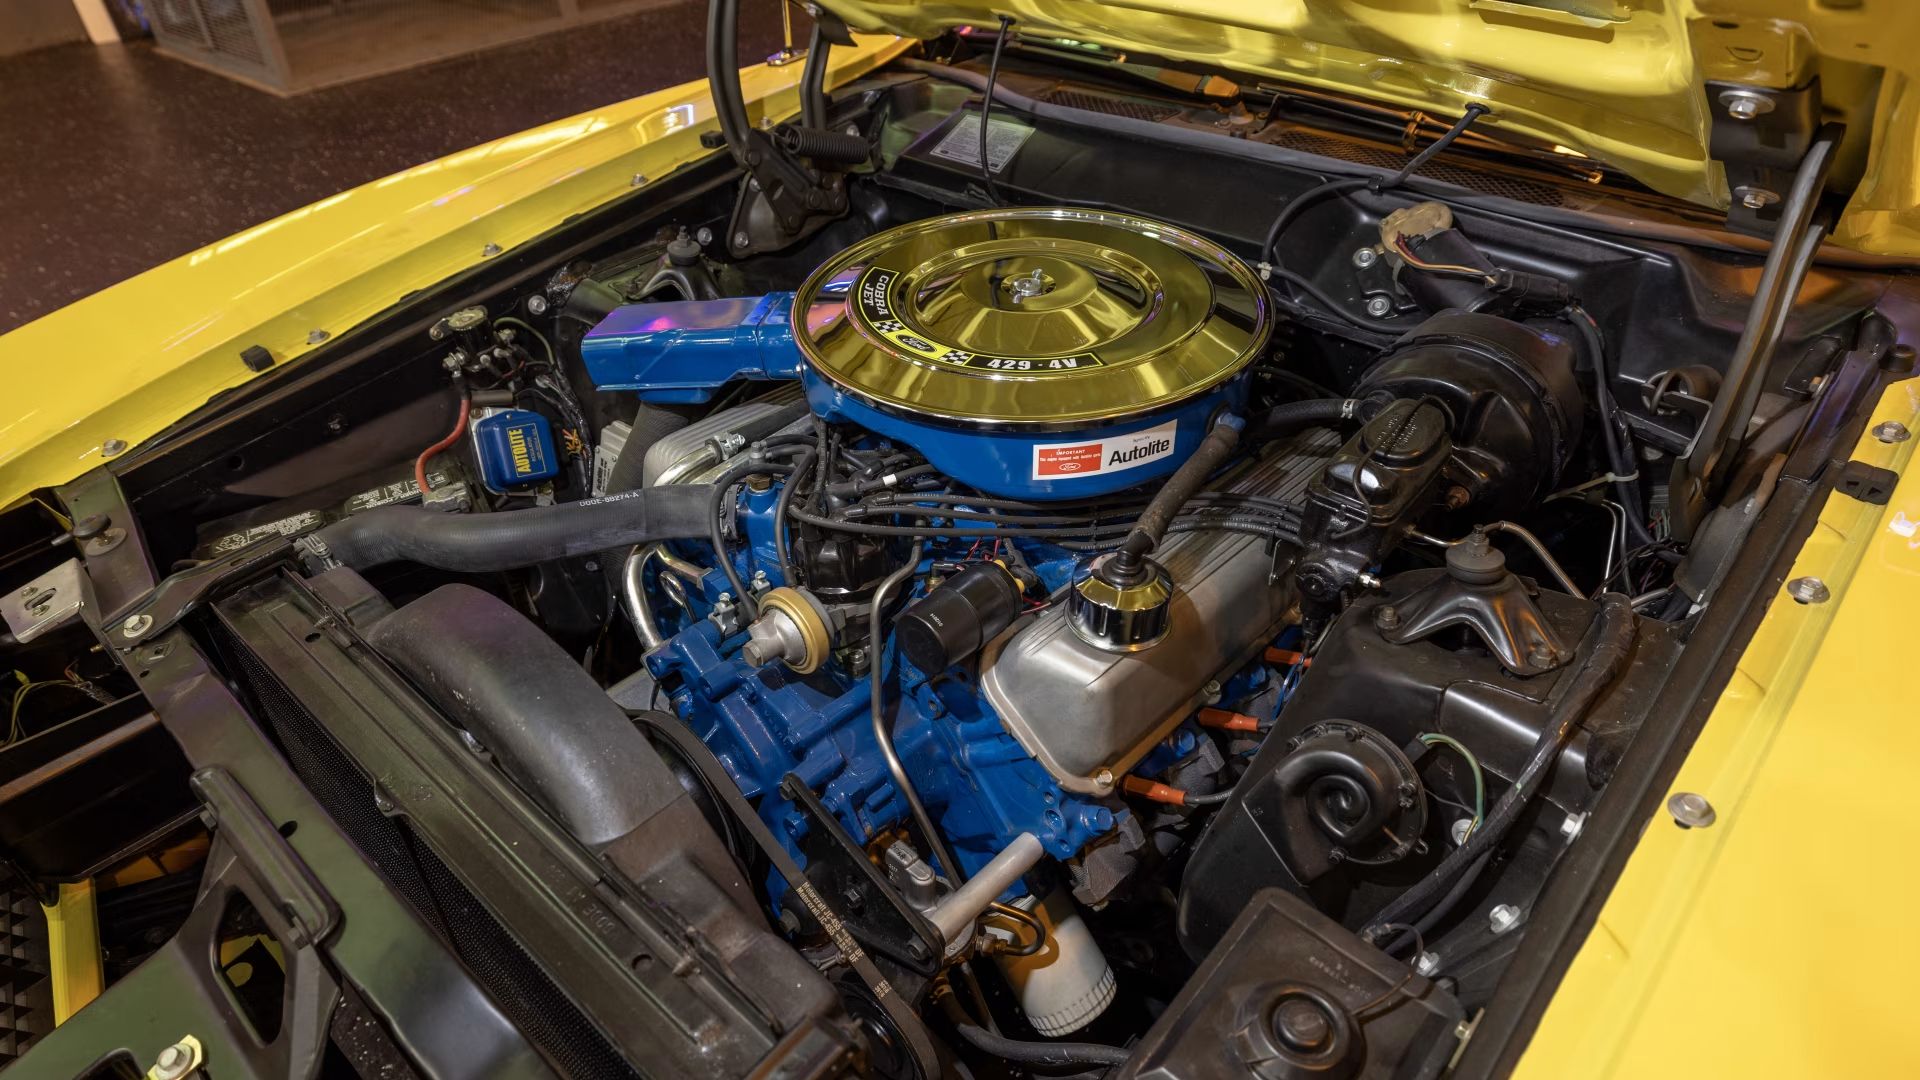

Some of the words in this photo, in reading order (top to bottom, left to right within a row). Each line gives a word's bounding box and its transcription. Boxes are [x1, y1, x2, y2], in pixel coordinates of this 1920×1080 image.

[863, 283, 874, 306] JET
[874, 275, 889, 316] COBRA
[899, 336, 933, 351] Ford
[987, 358, 1031, 370] 429
[1049, 358, 1078, 369] 4V
[508, 429, 532, 473] AUTOLITE
[1108, 439, 1170, 466] Autolite
[796, 886, 821, 917] Motorcraft
[818, 915, 836, 936] JC-455
[801, 881, 827, 912] Motorcraft
[823, 910, 842, 931] JC-455
